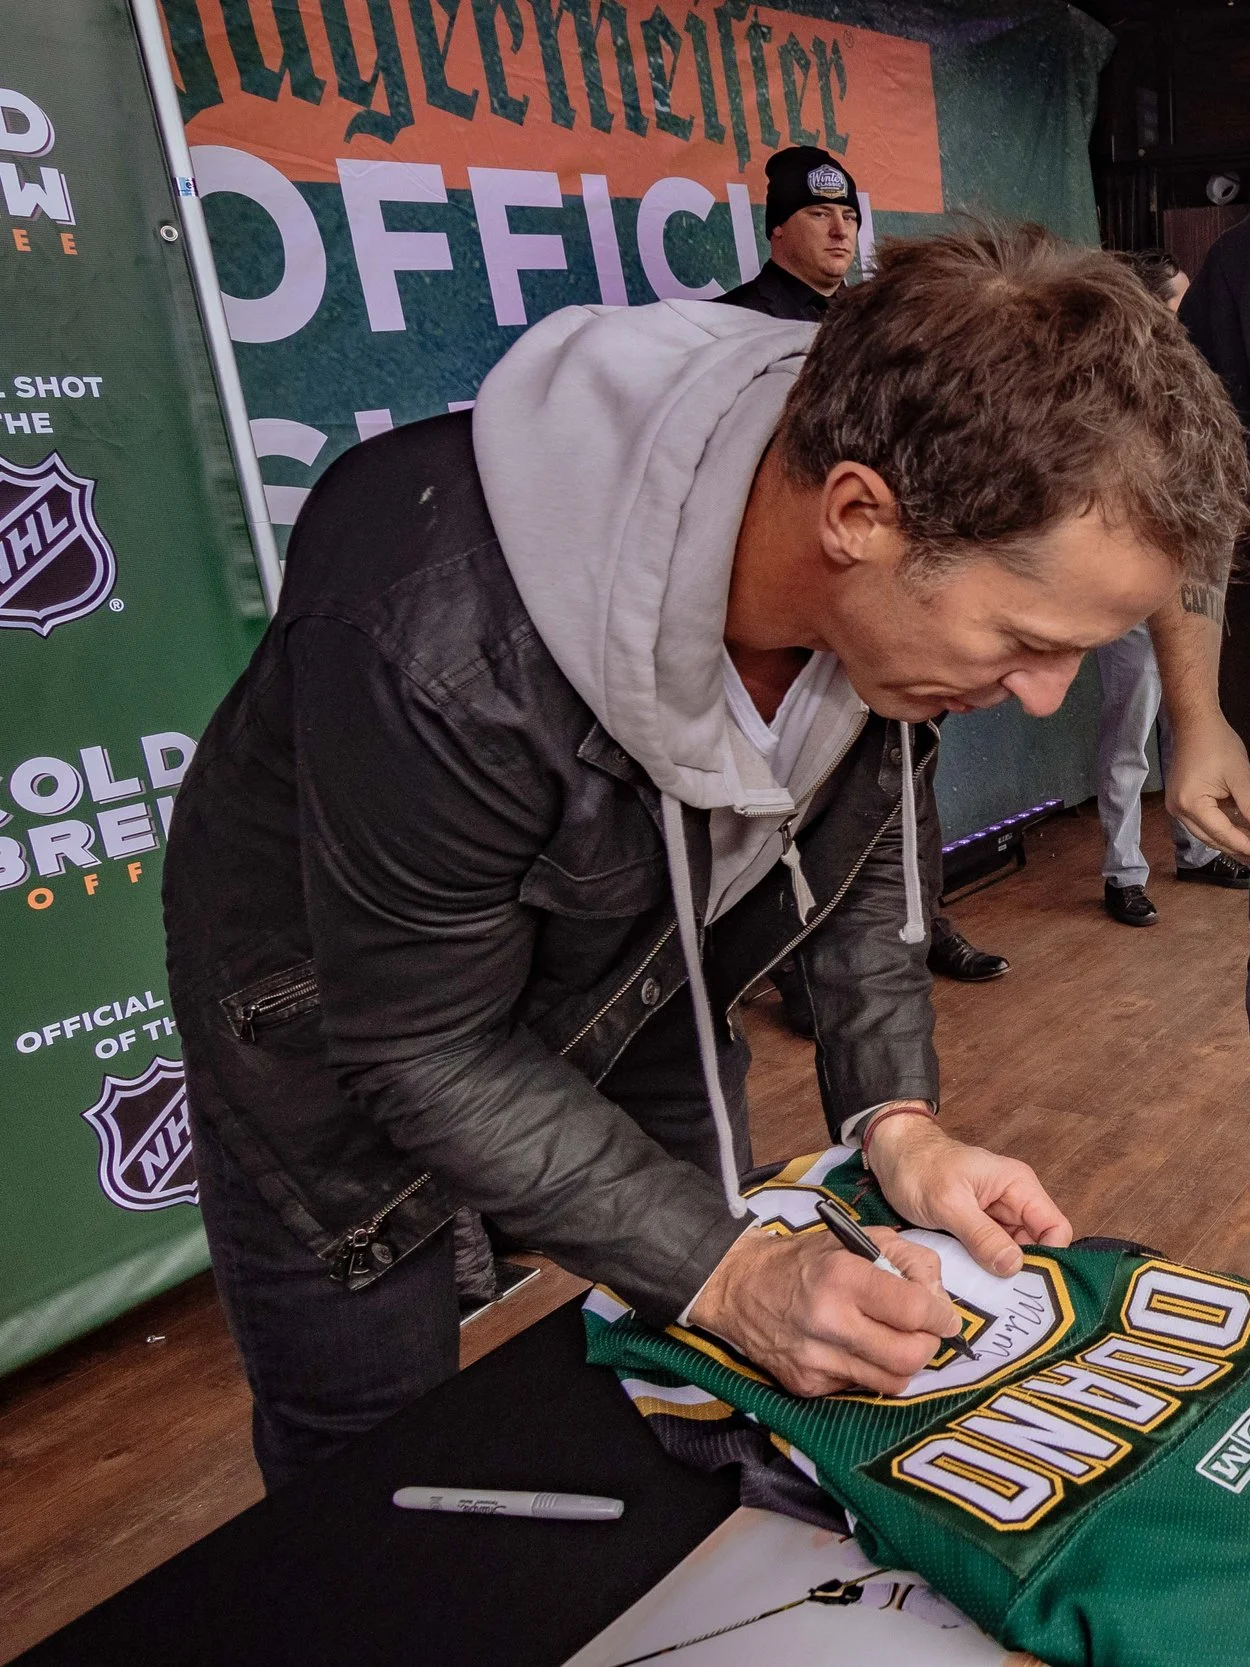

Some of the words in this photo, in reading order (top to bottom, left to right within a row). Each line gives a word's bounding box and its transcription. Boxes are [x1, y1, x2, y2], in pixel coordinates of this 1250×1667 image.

[13, 376, 103, 398] SHOT
[0, 412, 53, 434] HE
[0, 732, 199, 827] OLD
[16, 991, 164, 1053] OFFICIAL
[95, 1029, 136, 1059] OF
[142, 1017, 176, 1041] TH
[138, 1100, 191, 1187] NH
